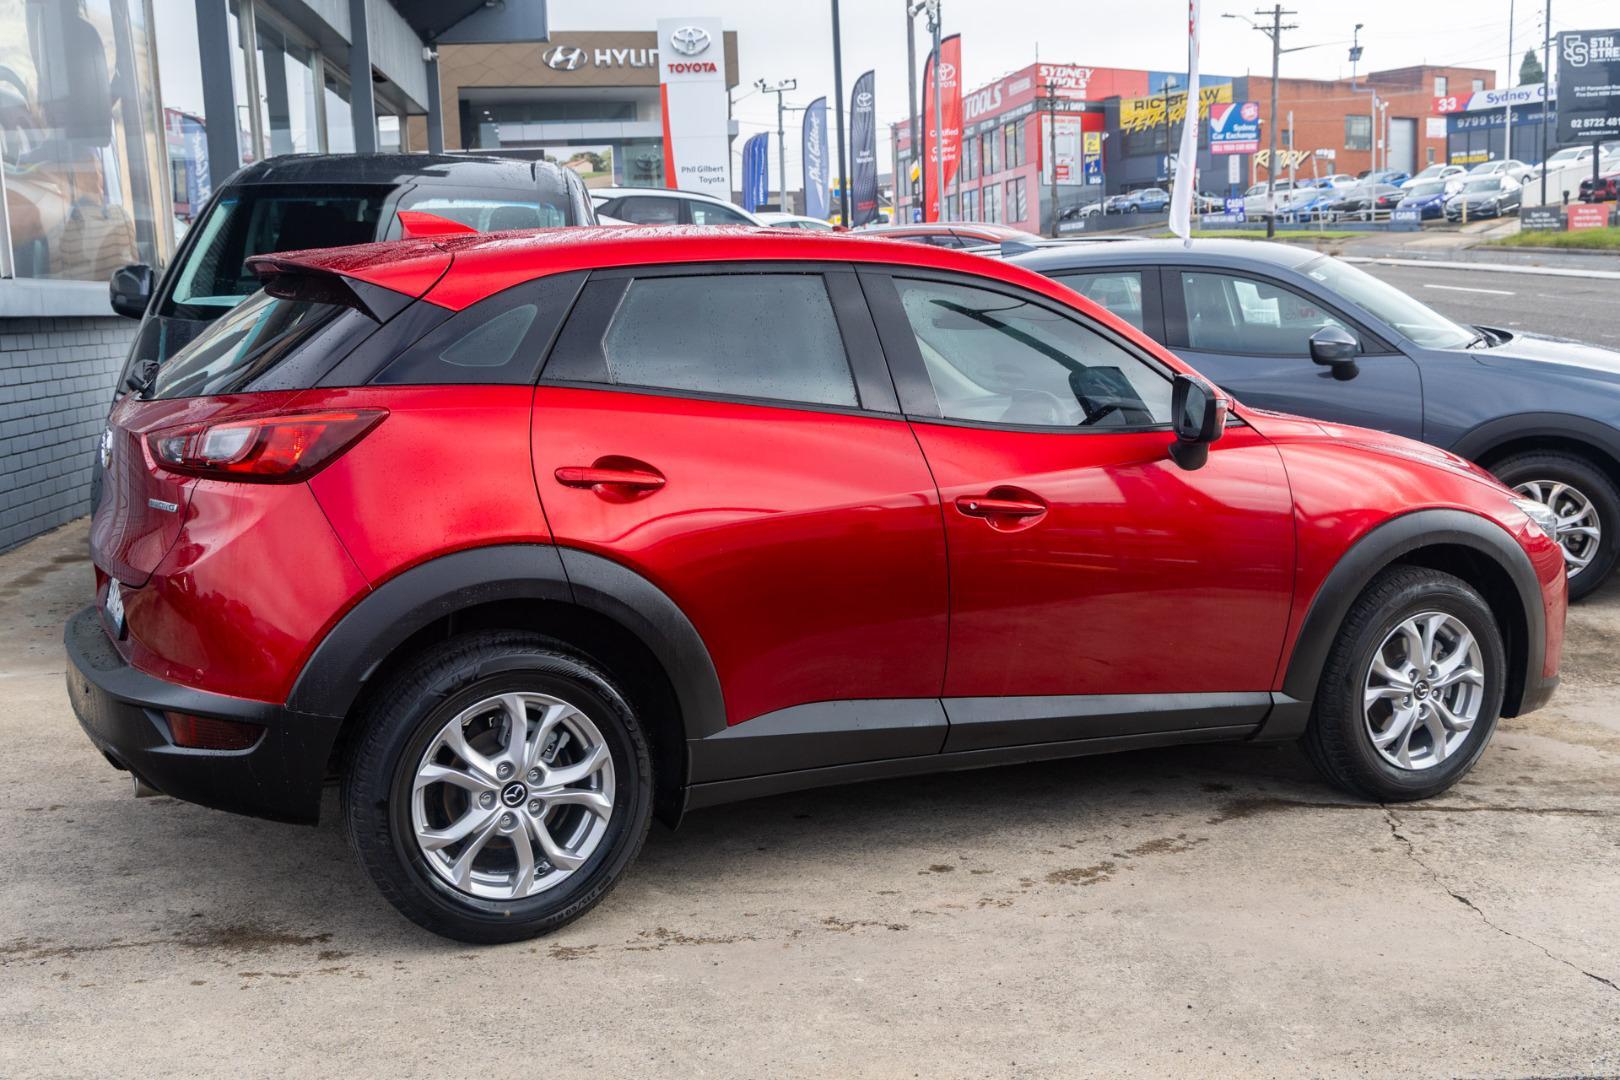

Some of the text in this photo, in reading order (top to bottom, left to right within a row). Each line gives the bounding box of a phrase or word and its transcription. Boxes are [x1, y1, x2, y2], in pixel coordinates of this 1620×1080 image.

[667, 62, 717, 74] TOYOTA
[1039, 65, 1094, 81] SYDNEY
[1045, 76, 1087, 89] TOOLS
[964, 83, 1002, 121] TOOLS
[1438, 97, 1457, 112] 33
[1486, 89, 1532, 105] Sydney
[1457, 112, 1519, 128] 9799 122
[697, 164, 724, 173] Gilbert
[699, 175, 725, 184] Toyota
